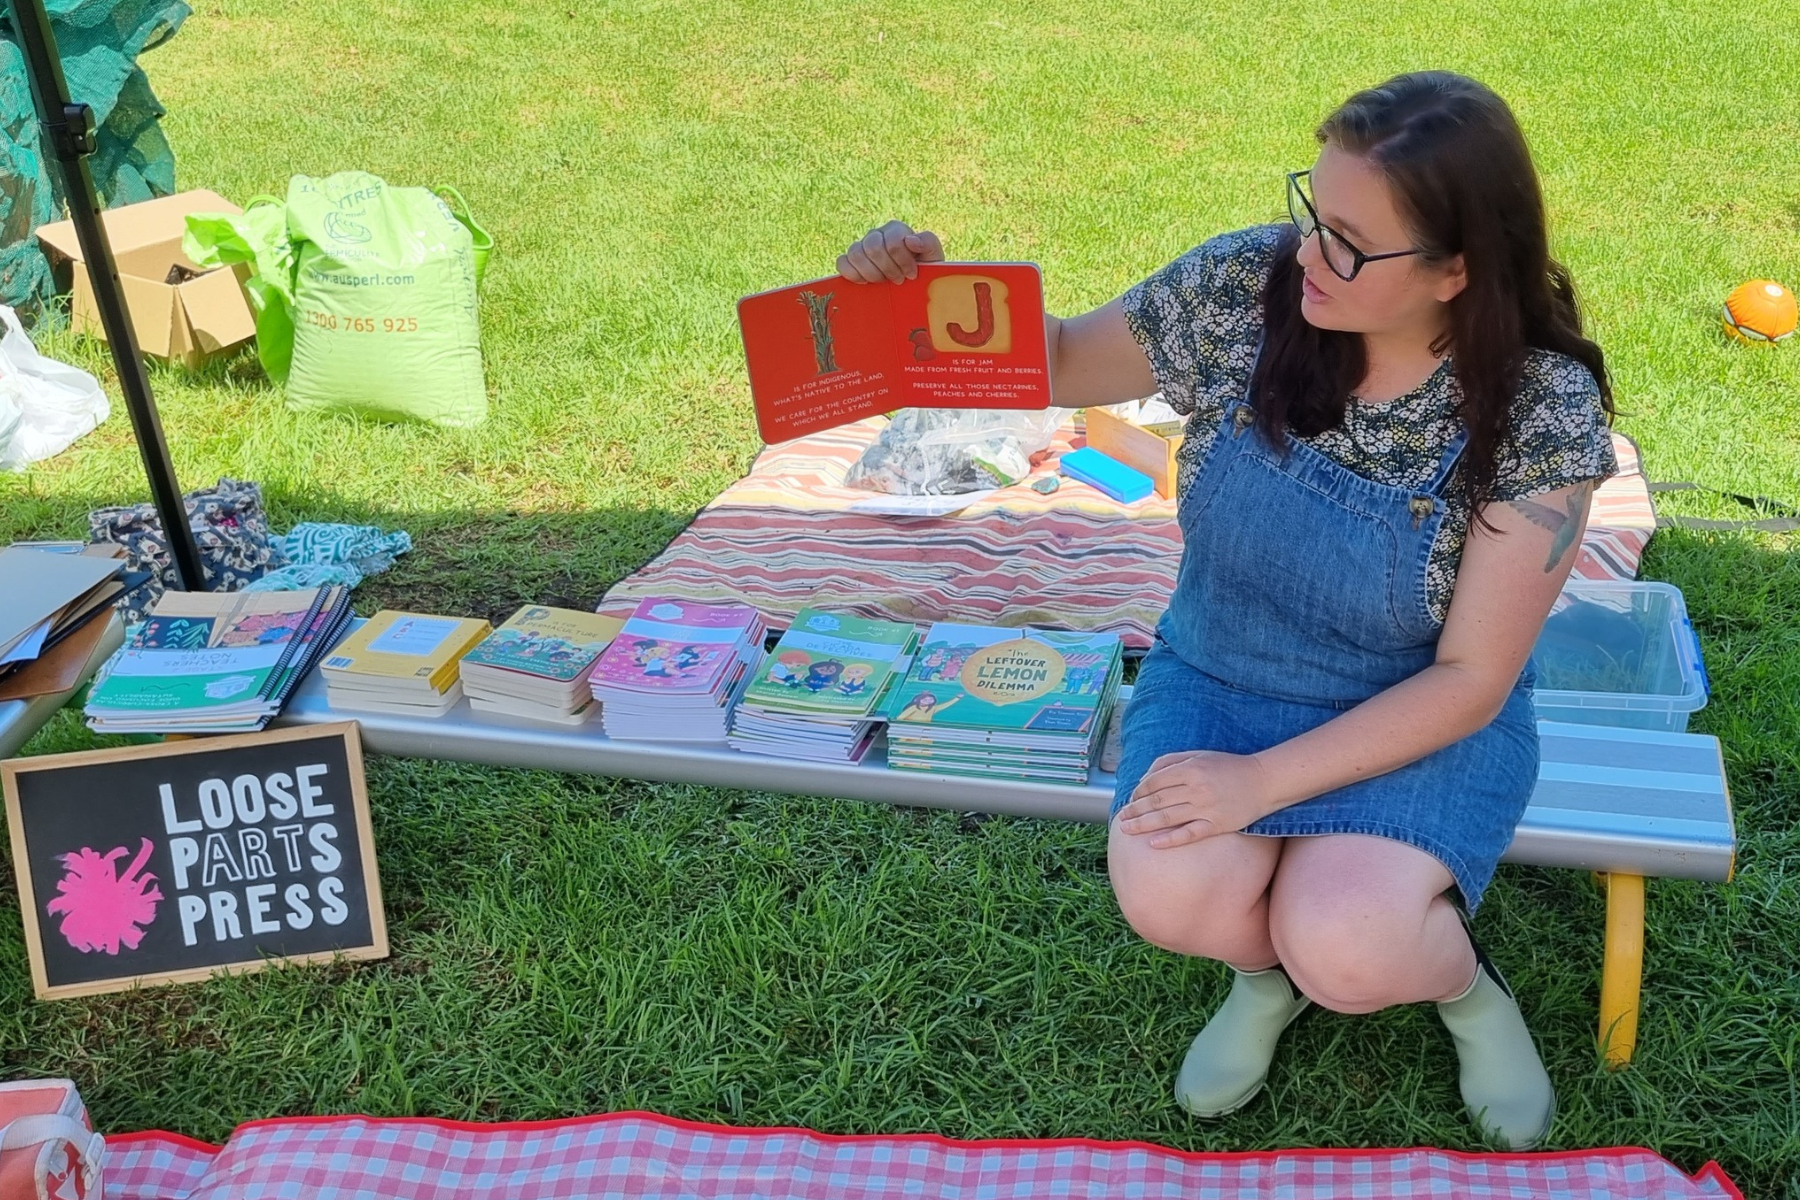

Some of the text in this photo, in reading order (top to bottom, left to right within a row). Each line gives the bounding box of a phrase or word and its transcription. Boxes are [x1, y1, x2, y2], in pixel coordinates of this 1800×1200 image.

[305, 310, 418, 333] 1300 765 925
[946, 282, 994, 348] J
[773, 393, 802, 407] WHAT'S
[804, 387, 831, 399] NATIVE
[833, 383, 845, 391] TO
[848, 379, 862, 388] THE
[802, 381, 817, 391] FOR
[774, 387, 889, 424] WE CARE FOR THE COUNTRY ON
[792, 415, 817, 427] WHICH
[818, 412, 830, 421] WE
[832, 408, 846, 417] ALL
[526, 621, 600, 639] PERMACULTURE
[180, 652, 232, 661] NOTES
[806, 642, 873, 658] DETECTIVES
[163, 658, 238, 668] TEACHERS
[986, 657, 1047, 668] LEFTOVER
[977, 666, 1048, 682] LEMON
[977, 680, 1035, 691] DILEMMA
[158, 763, 335, 836] LOOSE
[169, 822, 342, 890] PARTS
[178, 876, 349, 947] PRESS
